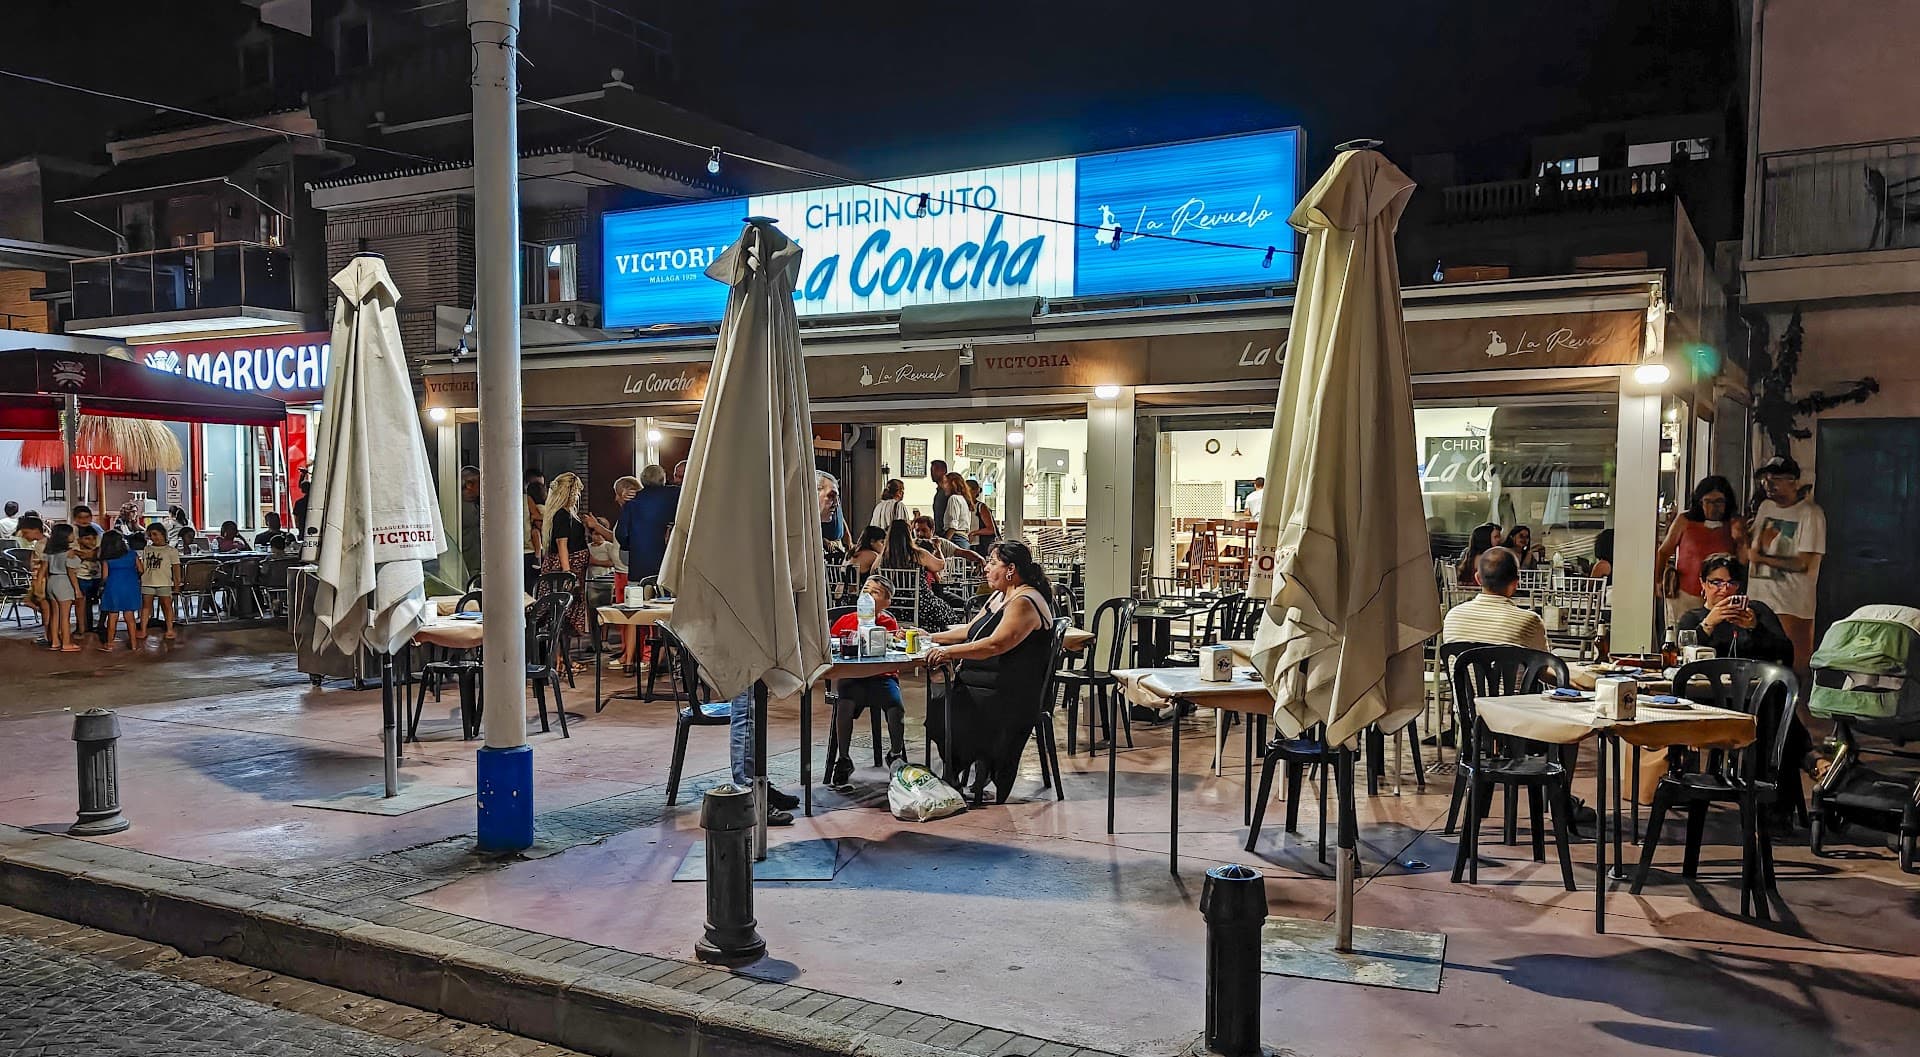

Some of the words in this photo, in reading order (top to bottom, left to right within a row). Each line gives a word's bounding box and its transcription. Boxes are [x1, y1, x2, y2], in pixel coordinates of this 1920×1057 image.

[1124, 205, 1164, 243] La
[1171, 194, 1273, 236] Revuelo
[792, 238, 840, 301] a
[849, 213, 1046, 298] Concha
[1239, 341, 1271, 367] La
[1508, 330, 1541, 356] La
[186, 344, 331, 391] MARUCHI
[873, 366, 892, 386] La
[895, 363, 947, 383] Revuelo
[985, 354, 1071, 370] VICTORIA
[430, 381, 475, 393] VICTORI
[623, 374, 644, 394] La
[645, 371, 696, 393] Concha
[1423, 450, 1463, 483] La
